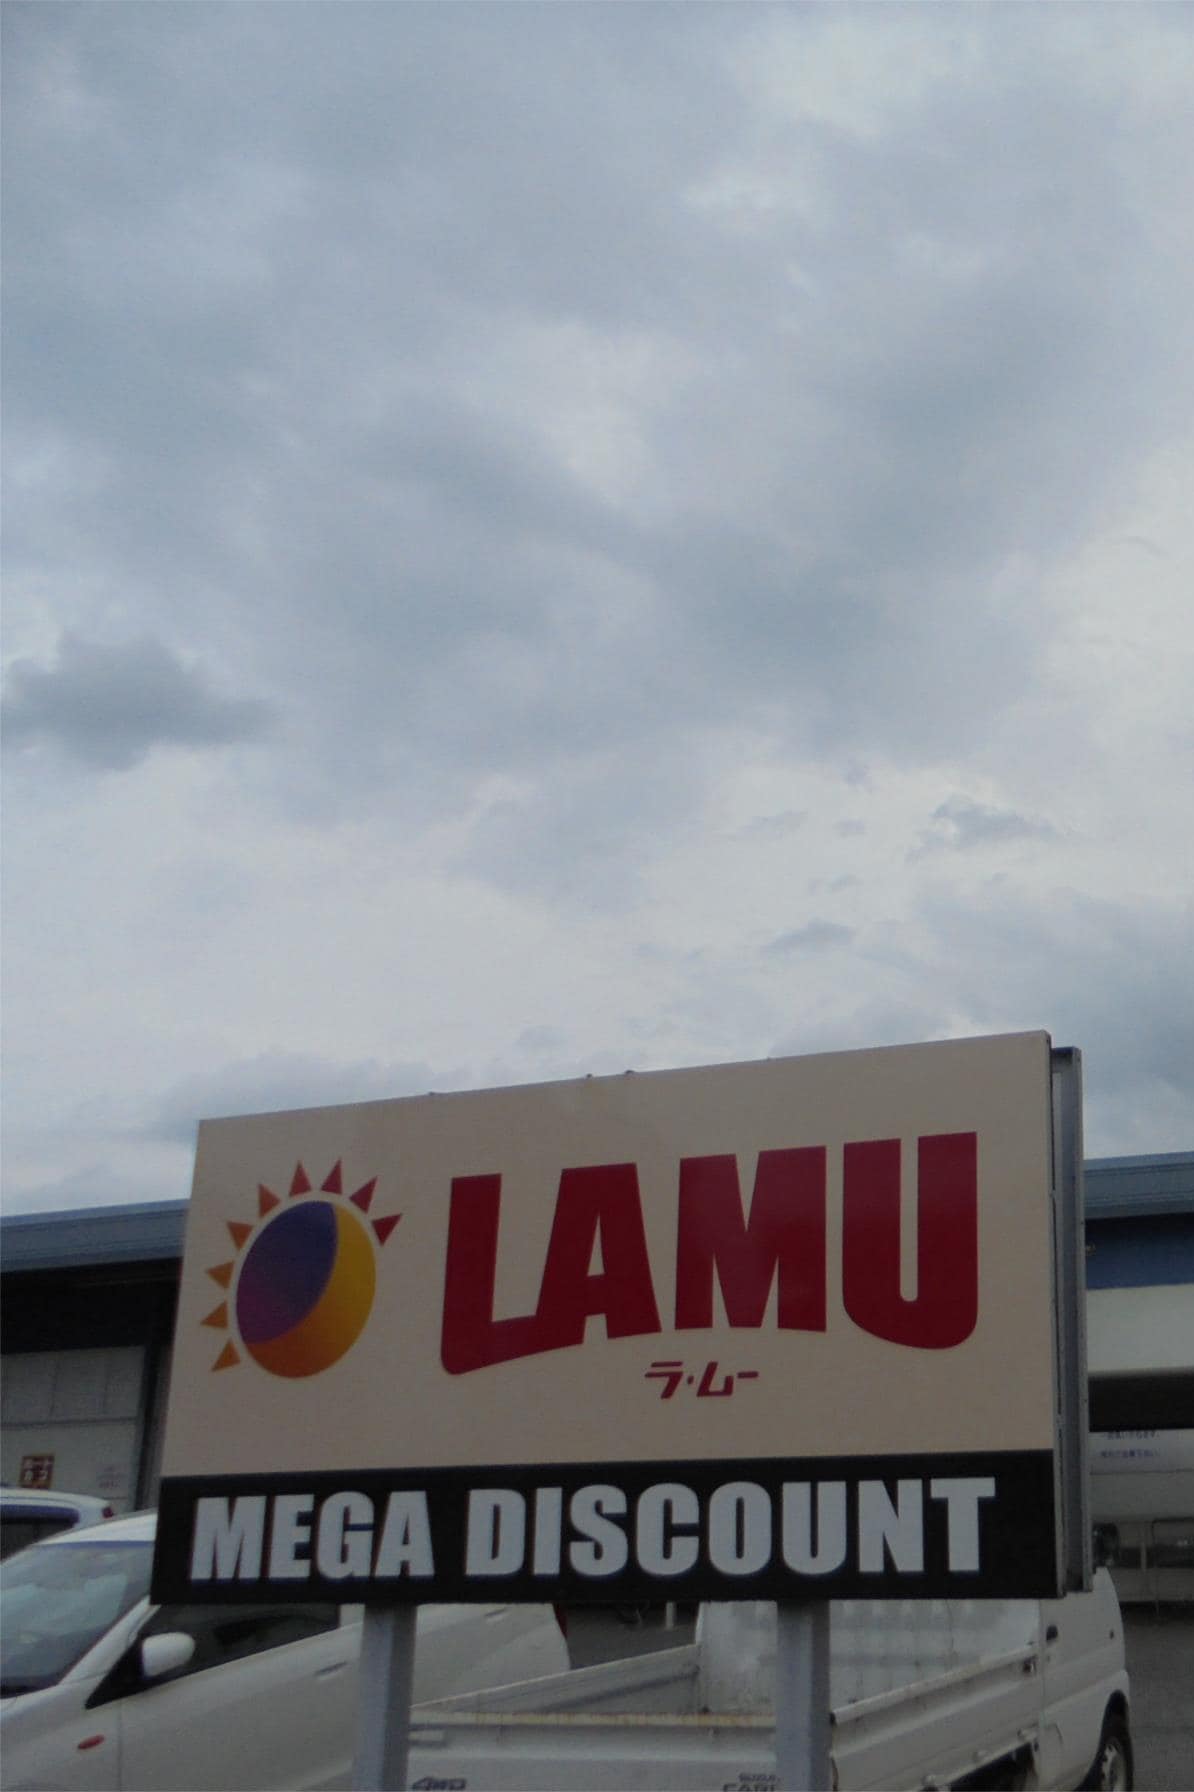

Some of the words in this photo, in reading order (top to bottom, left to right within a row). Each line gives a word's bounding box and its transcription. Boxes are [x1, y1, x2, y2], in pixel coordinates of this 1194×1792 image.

[441, 1132, 978, 1375] LAMU
[190, 1491, 435, 1582] MEGA
[465, 1477, 997, 1577] DISCOUNT
